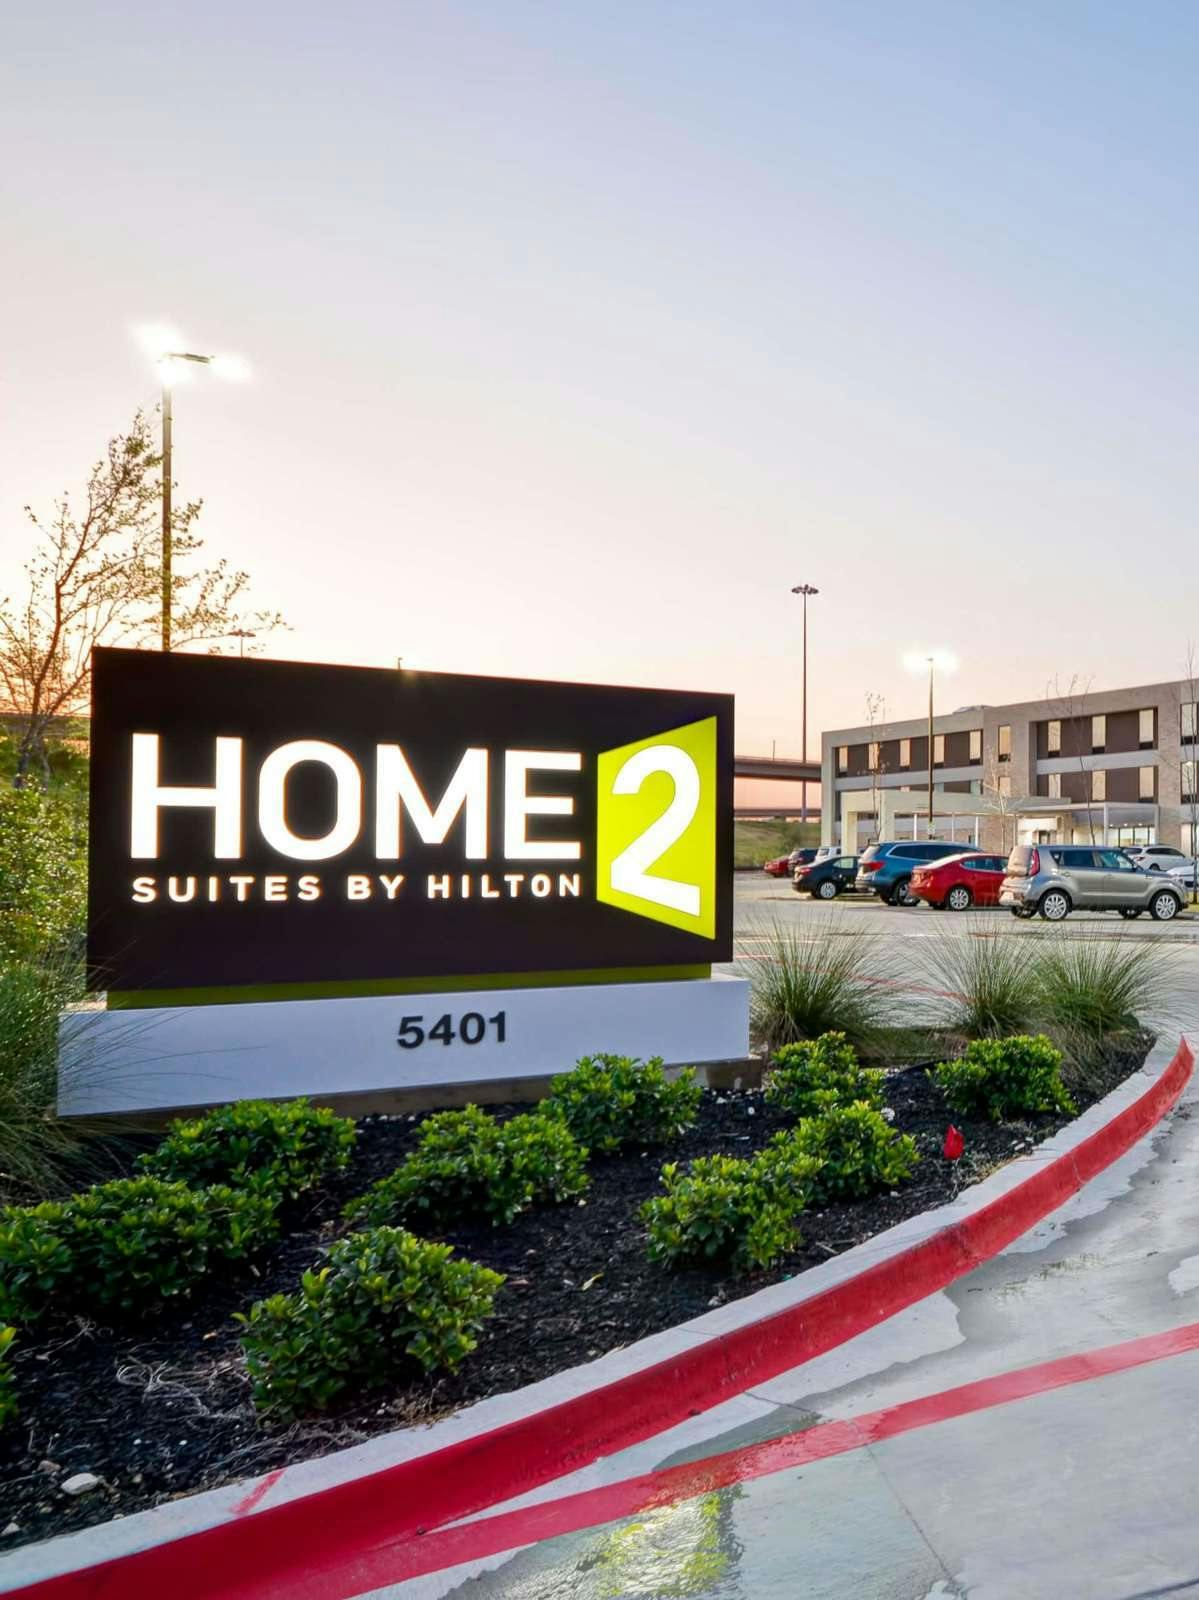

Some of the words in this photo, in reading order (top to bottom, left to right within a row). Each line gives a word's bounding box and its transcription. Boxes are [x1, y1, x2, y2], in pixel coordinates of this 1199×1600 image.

[130, 732, 582, 862] HOME
[610, 744, 701, 918] 2
[131, 876, 321, 902] SUITES
[346, 874, 404, 900] BY
[427, 873, 581, 899] HILTON
[396, 1010, 507, 1049] 5401
